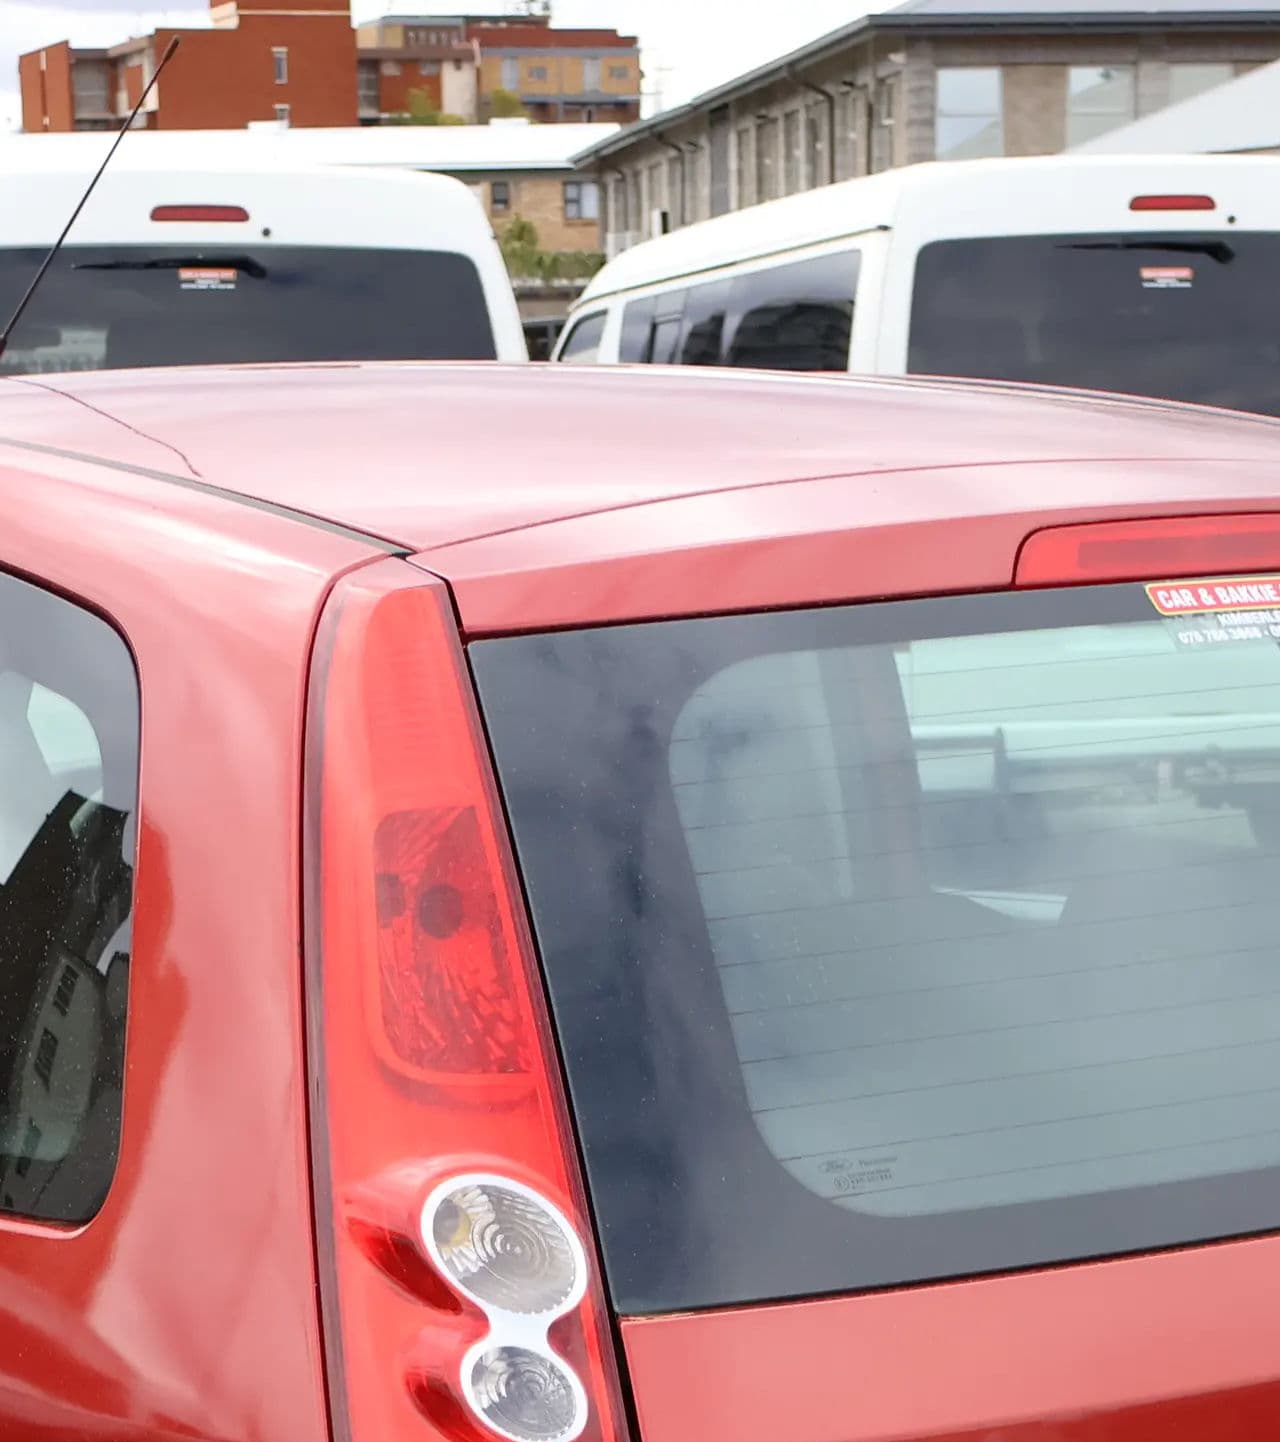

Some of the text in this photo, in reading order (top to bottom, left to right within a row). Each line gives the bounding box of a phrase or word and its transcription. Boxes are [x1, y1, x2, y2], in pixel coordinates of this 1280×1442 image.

[1156, 588, 1198, 609] CAR
[1198, 587, 1217, 607] &
[1214, 583, 1280, 605] BAKKIE
